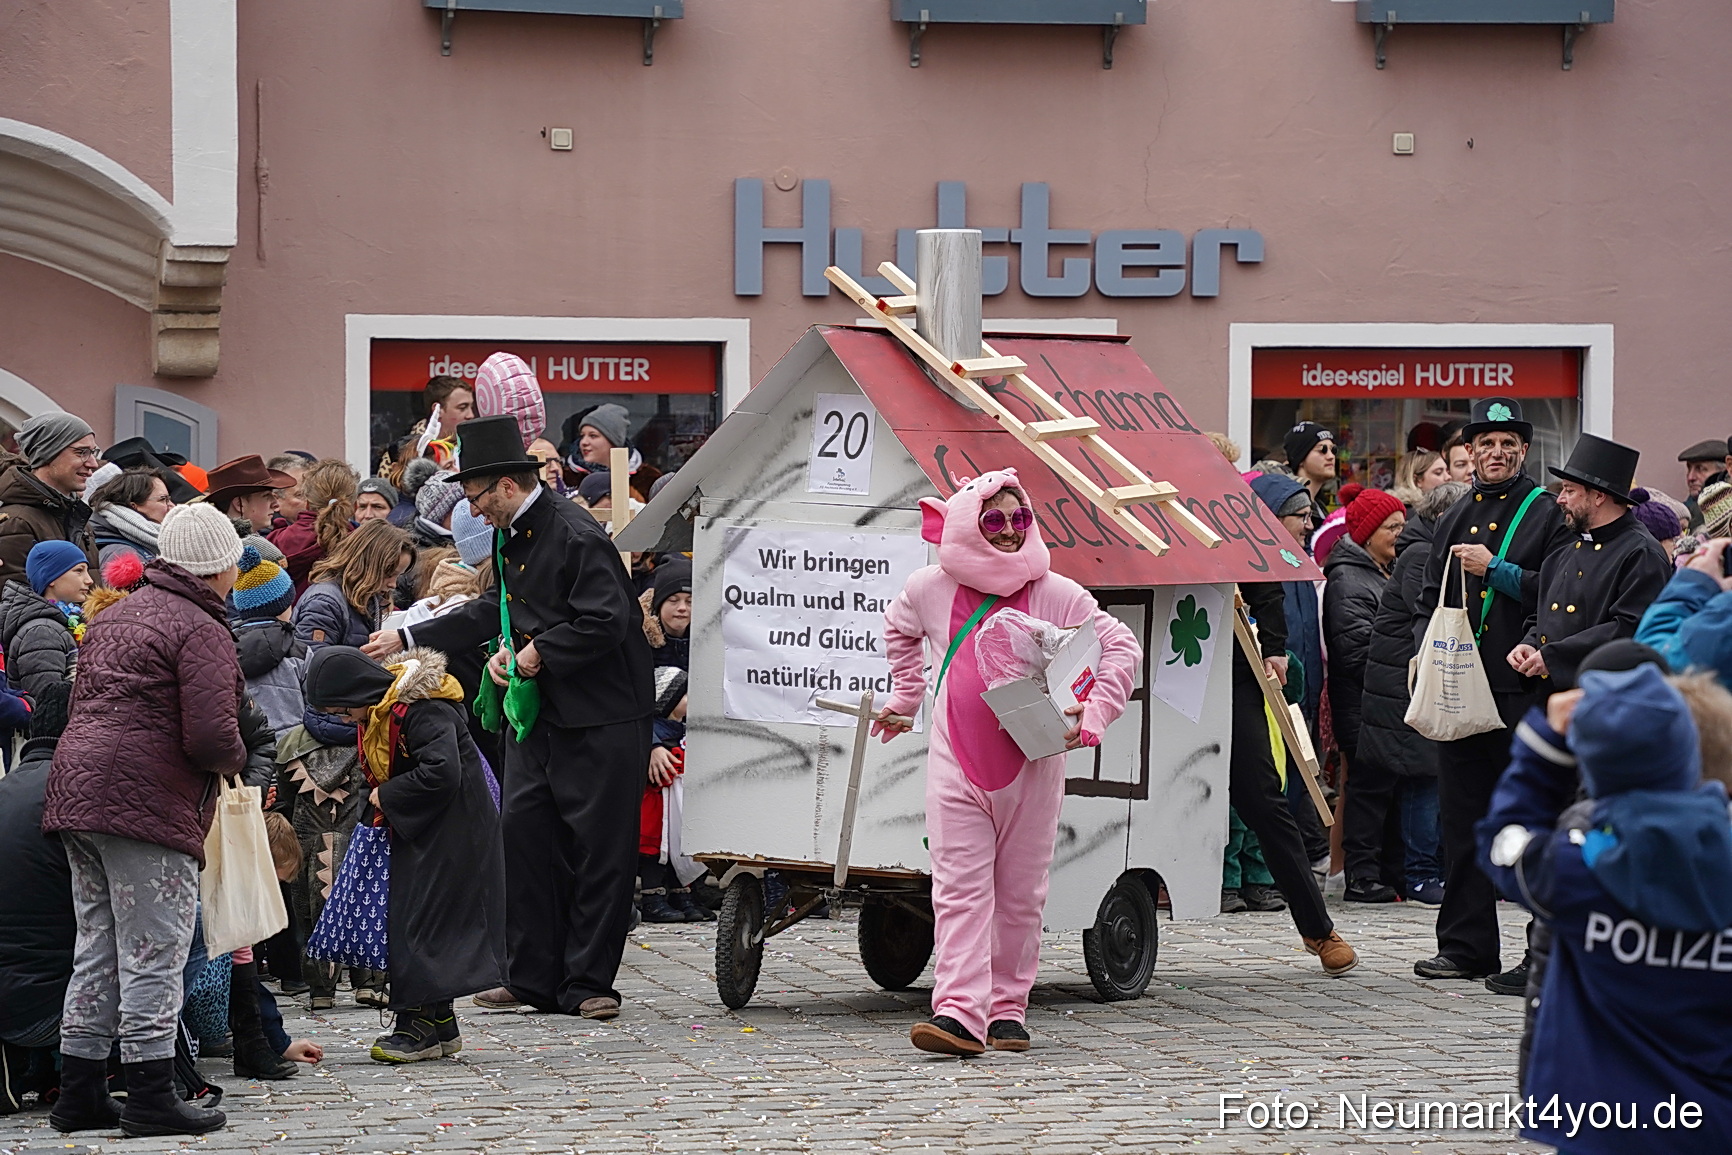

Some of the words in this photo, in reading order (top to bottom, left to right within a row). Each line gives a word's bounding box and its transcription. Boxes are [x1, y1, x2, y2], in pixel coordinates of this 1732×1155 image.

[549, 356, 650, 382] HUTTER
[1302, 362, 1404, 390] idee+spiel
[1415, 363, 1514, 387] HUTTER
[817, 410, 869, 460] 20
[758, 548, 797, 570] Wir
[803, 550, 890, 579] bringen
[724, 584, 796, 610] Qualm
[803, 590, 845, 611] und
[768, 626, 811, 648] und
[818, 628, 877, 652] Glück
[746, 666, 842, 691] natürlich
